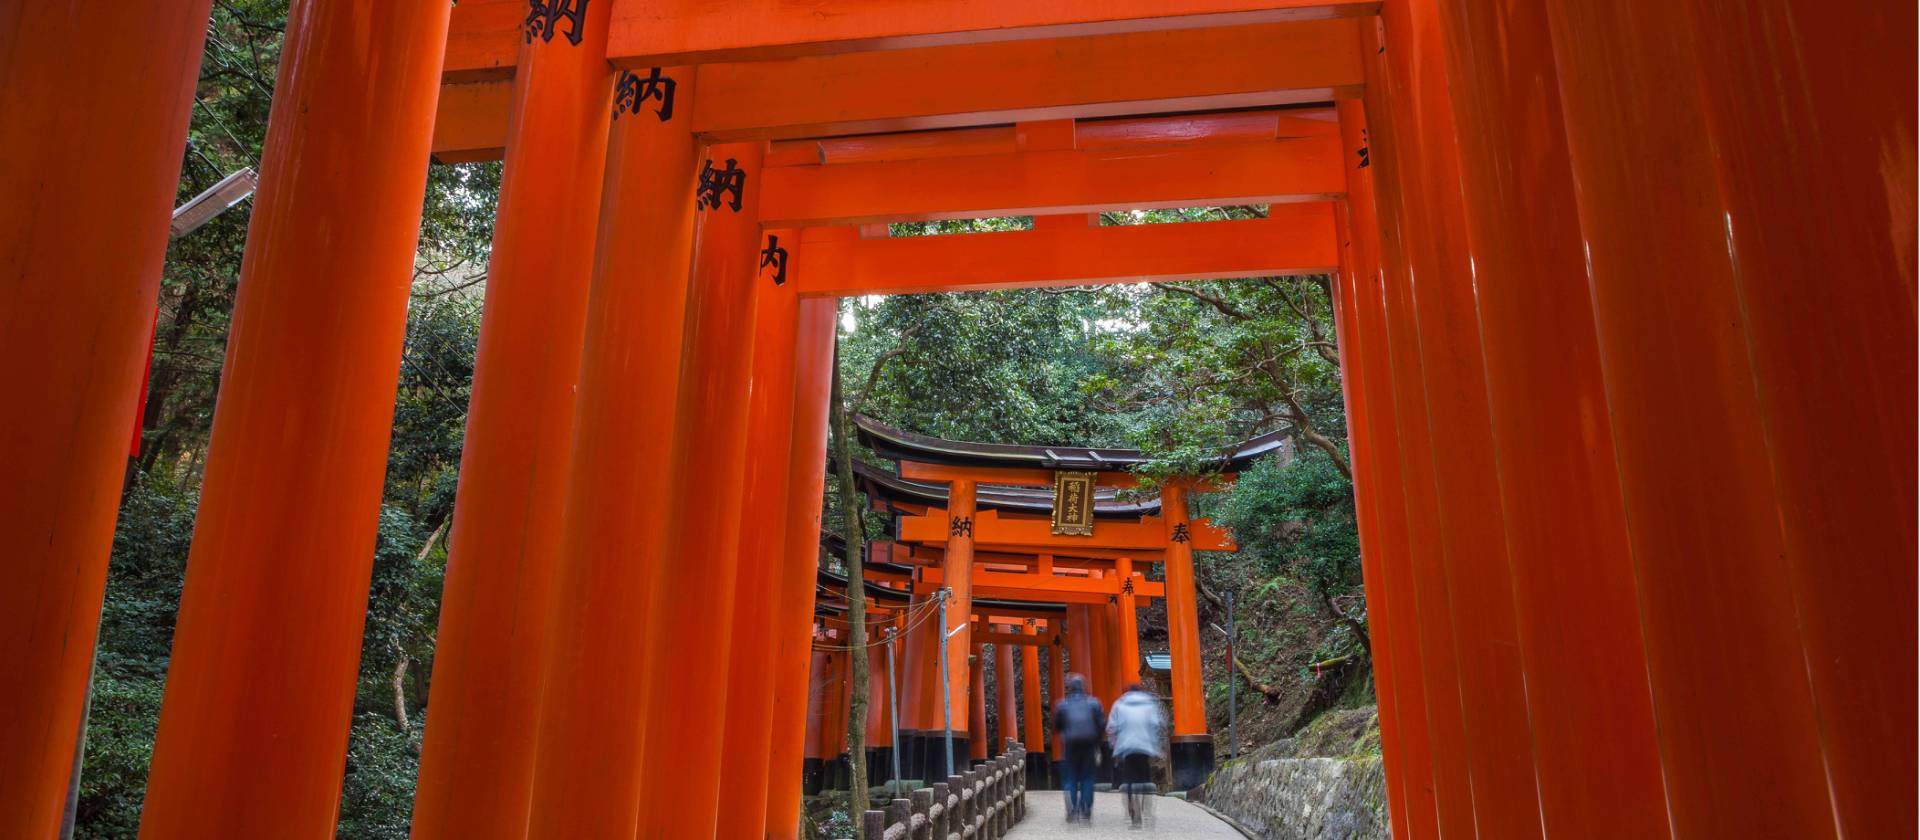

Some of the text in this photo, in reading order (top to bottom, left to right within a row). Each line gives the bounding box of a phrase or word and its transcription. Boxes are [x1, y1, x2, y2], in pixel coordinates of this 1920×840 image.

[526, 0, 589, 46] 納
[612, 67, 676, 121] 納
[697, 158, 746, 212] 納
[952, 516, 972, 538] 納
[1171, 523, 1190, 544] 奉
